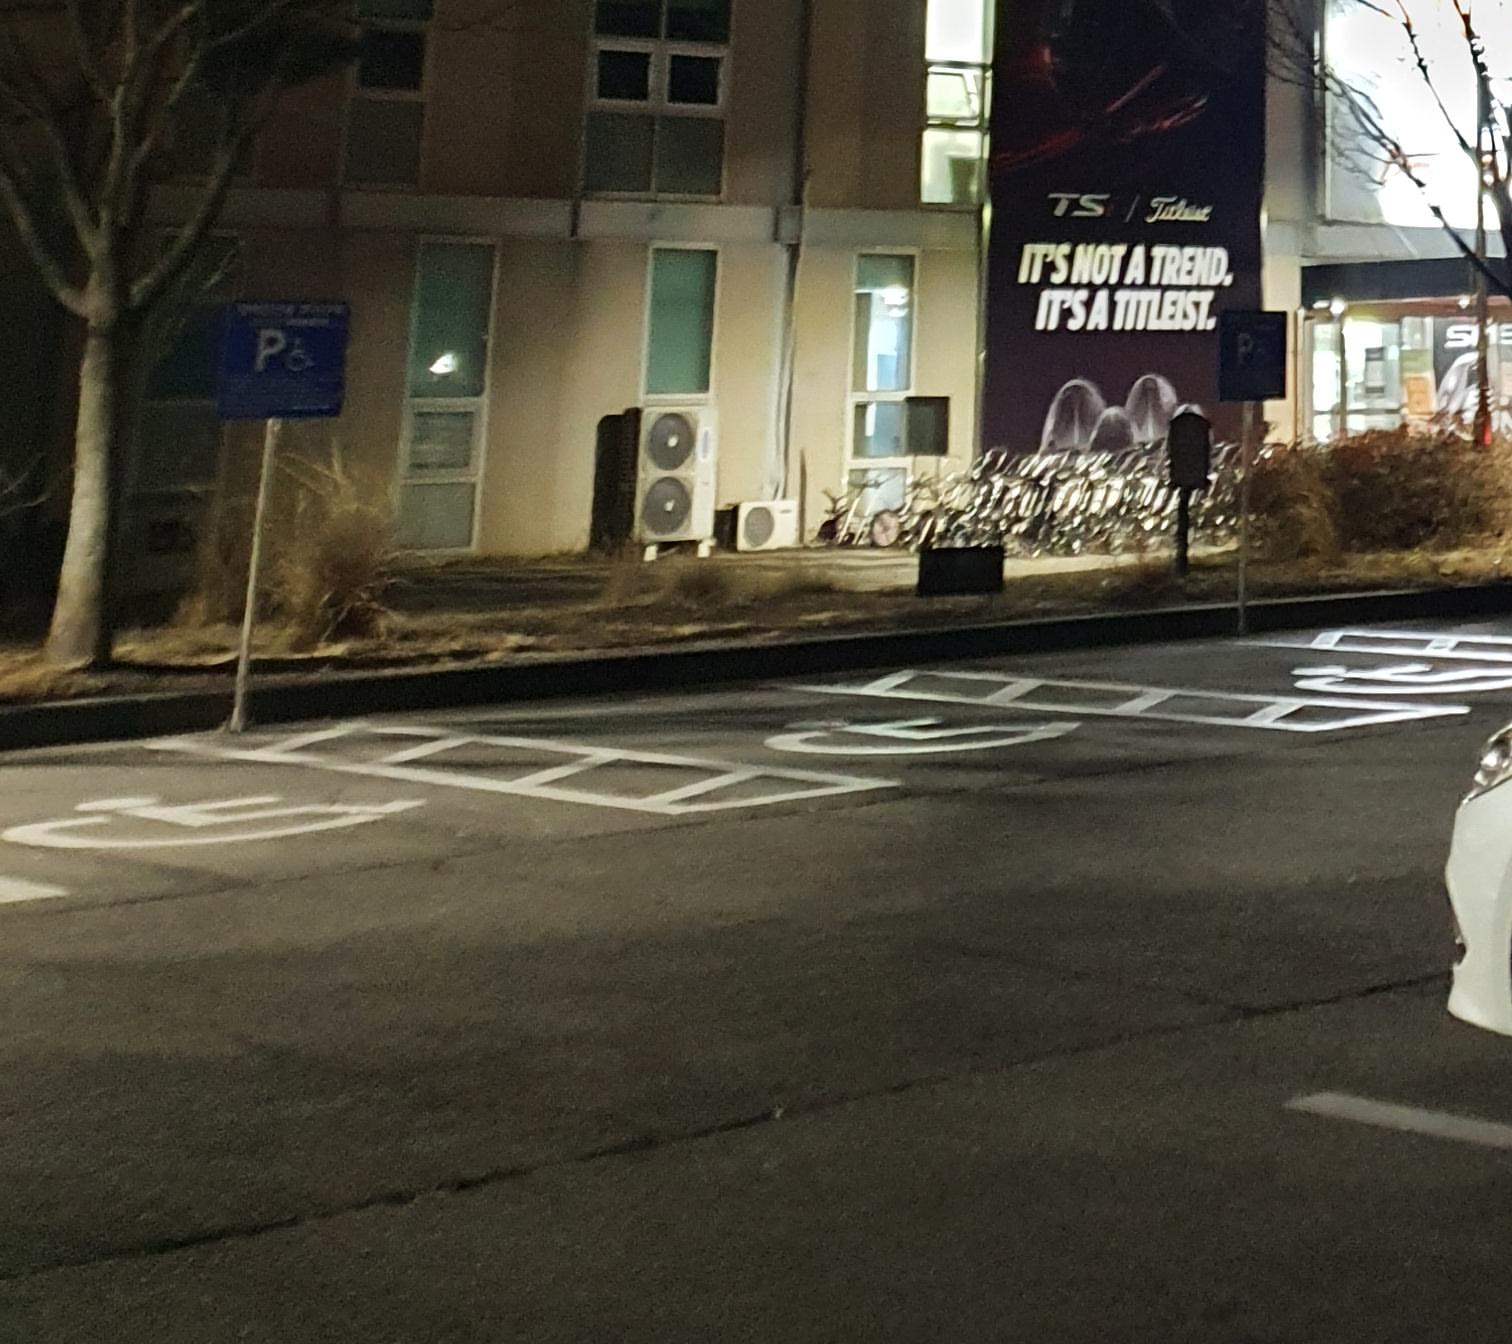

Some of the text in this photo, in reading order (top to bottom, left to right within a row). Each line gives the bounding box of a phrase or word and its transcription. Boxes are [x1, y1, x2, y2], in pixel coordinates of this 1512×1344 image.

[1017, 242, 1234, 287] IT'S NOT A TREND.
[1034, 288, 1091, 331] IT'S
[1085, 288, 1111, 331] A
[1111, 289, 1217, 331] TITLEIST.
[254, 328, 287, 372] P
